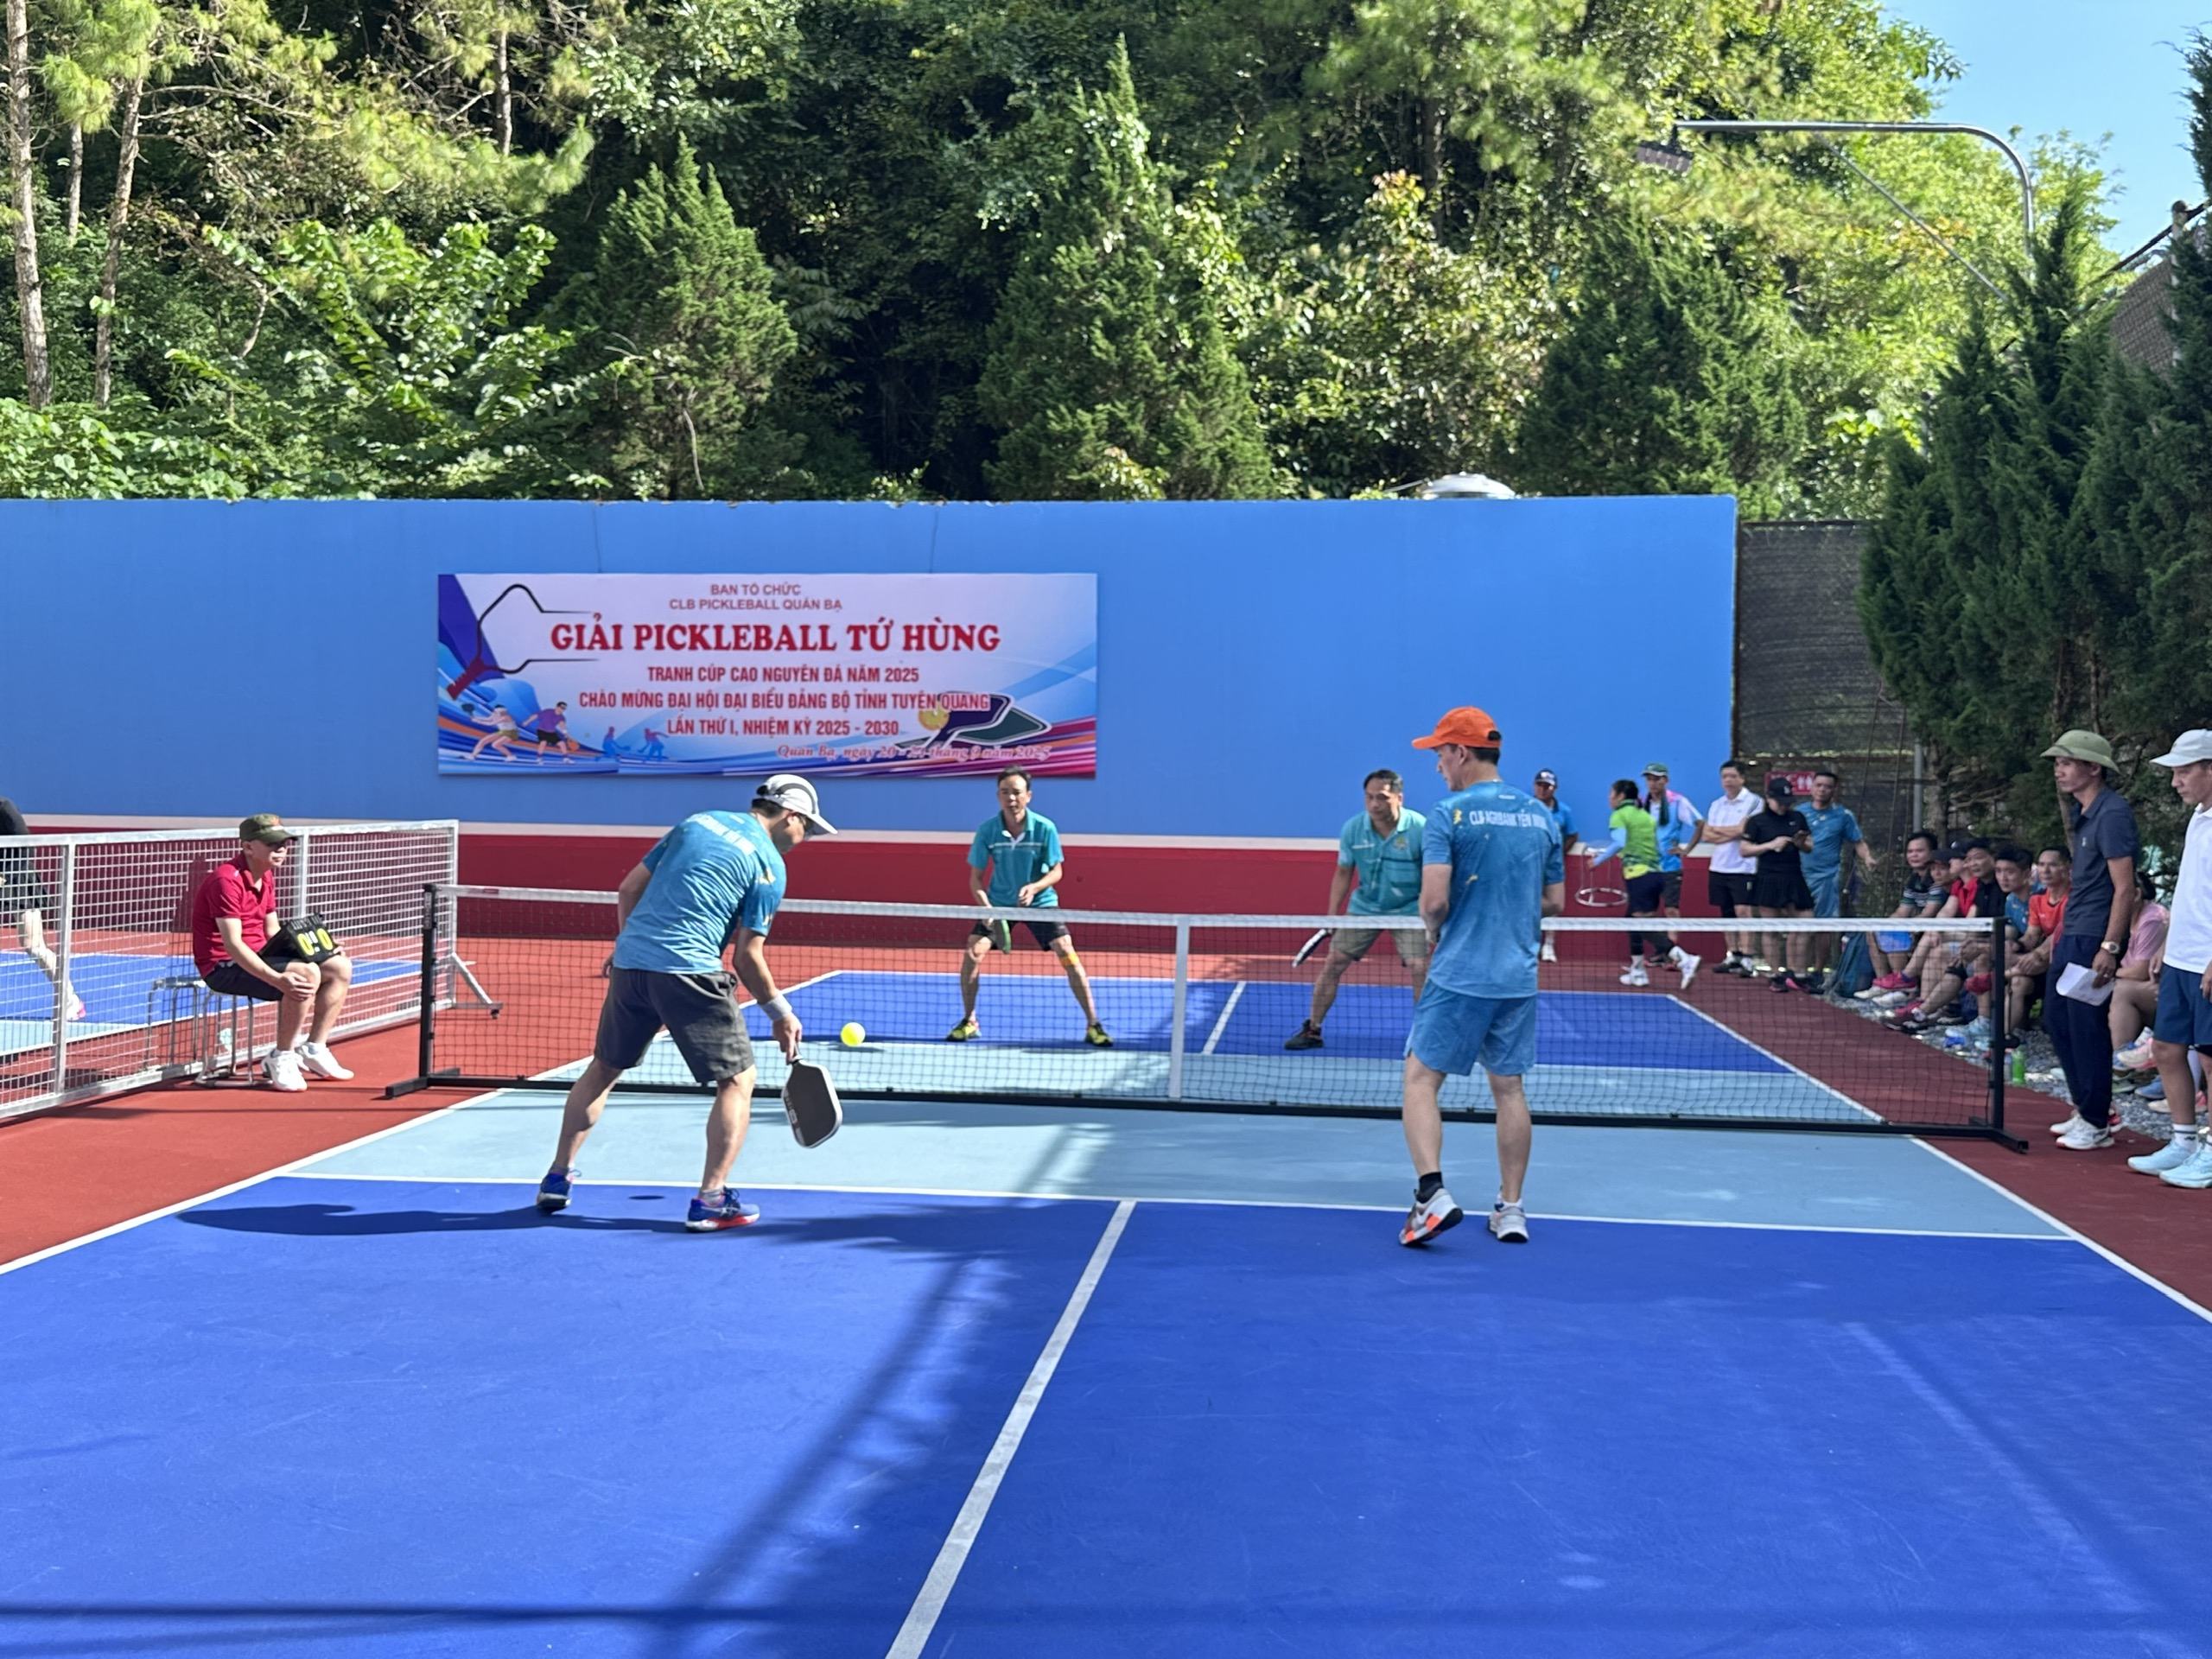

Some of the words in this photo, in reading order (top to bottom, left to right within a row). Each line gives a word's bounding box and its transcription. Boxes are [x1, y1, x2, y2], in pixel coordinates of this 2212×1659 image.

[711, 584, 737, 595] BAN
[763, 581, 801, 595] CHỨC
[670, 599, 695, 610] CLB
[699, 599, 779, 610] PICKLEBALL
[551, 613, 623, 651] GIẢI
[633, 623, 837, 652] PICKLEBALL
[846, 616, 894, 652] TỨ
[902, 616, 1001, 652] HÙNG
[647, 666, 693, 683] TRANH
[697, 664, 726, 683] CÚP
[730, 666, 758, 683] CAO
[763, 664, 819, 683] NGUYÊN
[823, 664, 842, 683] ĐÁ
[847, 664, 880, 683] NĂM
[885, 667, 919, 683] 2025
[579, 690, 617, 709] CHÀO
[621, 690, 664, 709] MỪNG
[668, 692, 691, 712] ĐẠI
[696, 690, 719, 712] HỘI
[723, 692, 747, 713] ĐẠI
[788, 689, 827, 709] ĐẢNG
[831, 690, 850, 712] BỘ
[892, 690, 936, 710] TUYÊN
[941, 693, 990, 710] QUANG
[699, 716, 727, 735] THỨ
[743, 716, 789, 739] NHIỆM
[816, 720, 850, 736] 2025
[864, 720, 899, 736] 2030
